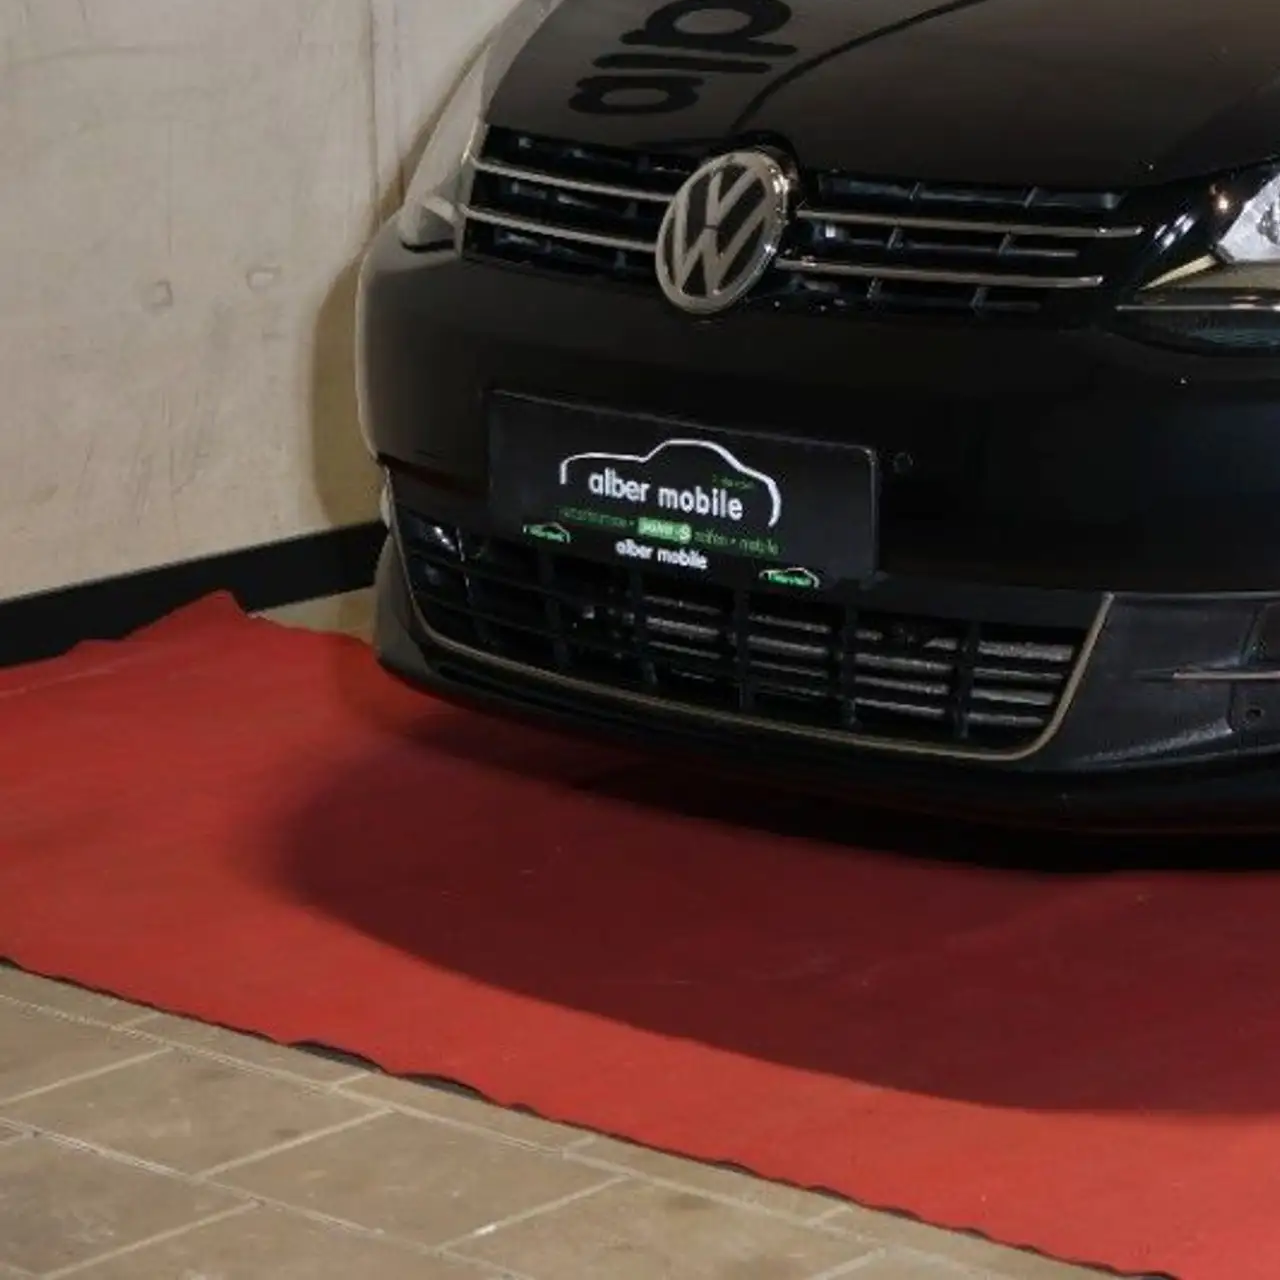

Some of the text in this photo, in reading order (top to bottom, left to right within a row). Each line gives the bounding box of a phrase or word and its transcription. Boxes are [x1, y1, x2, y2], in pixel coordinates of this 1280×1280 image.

[655, 151, 789, 315] VW
[588, 467, 650, 502] alber
[657, 485, 744, 521] mobile
[615, 537, 708, 570] alber mobile
